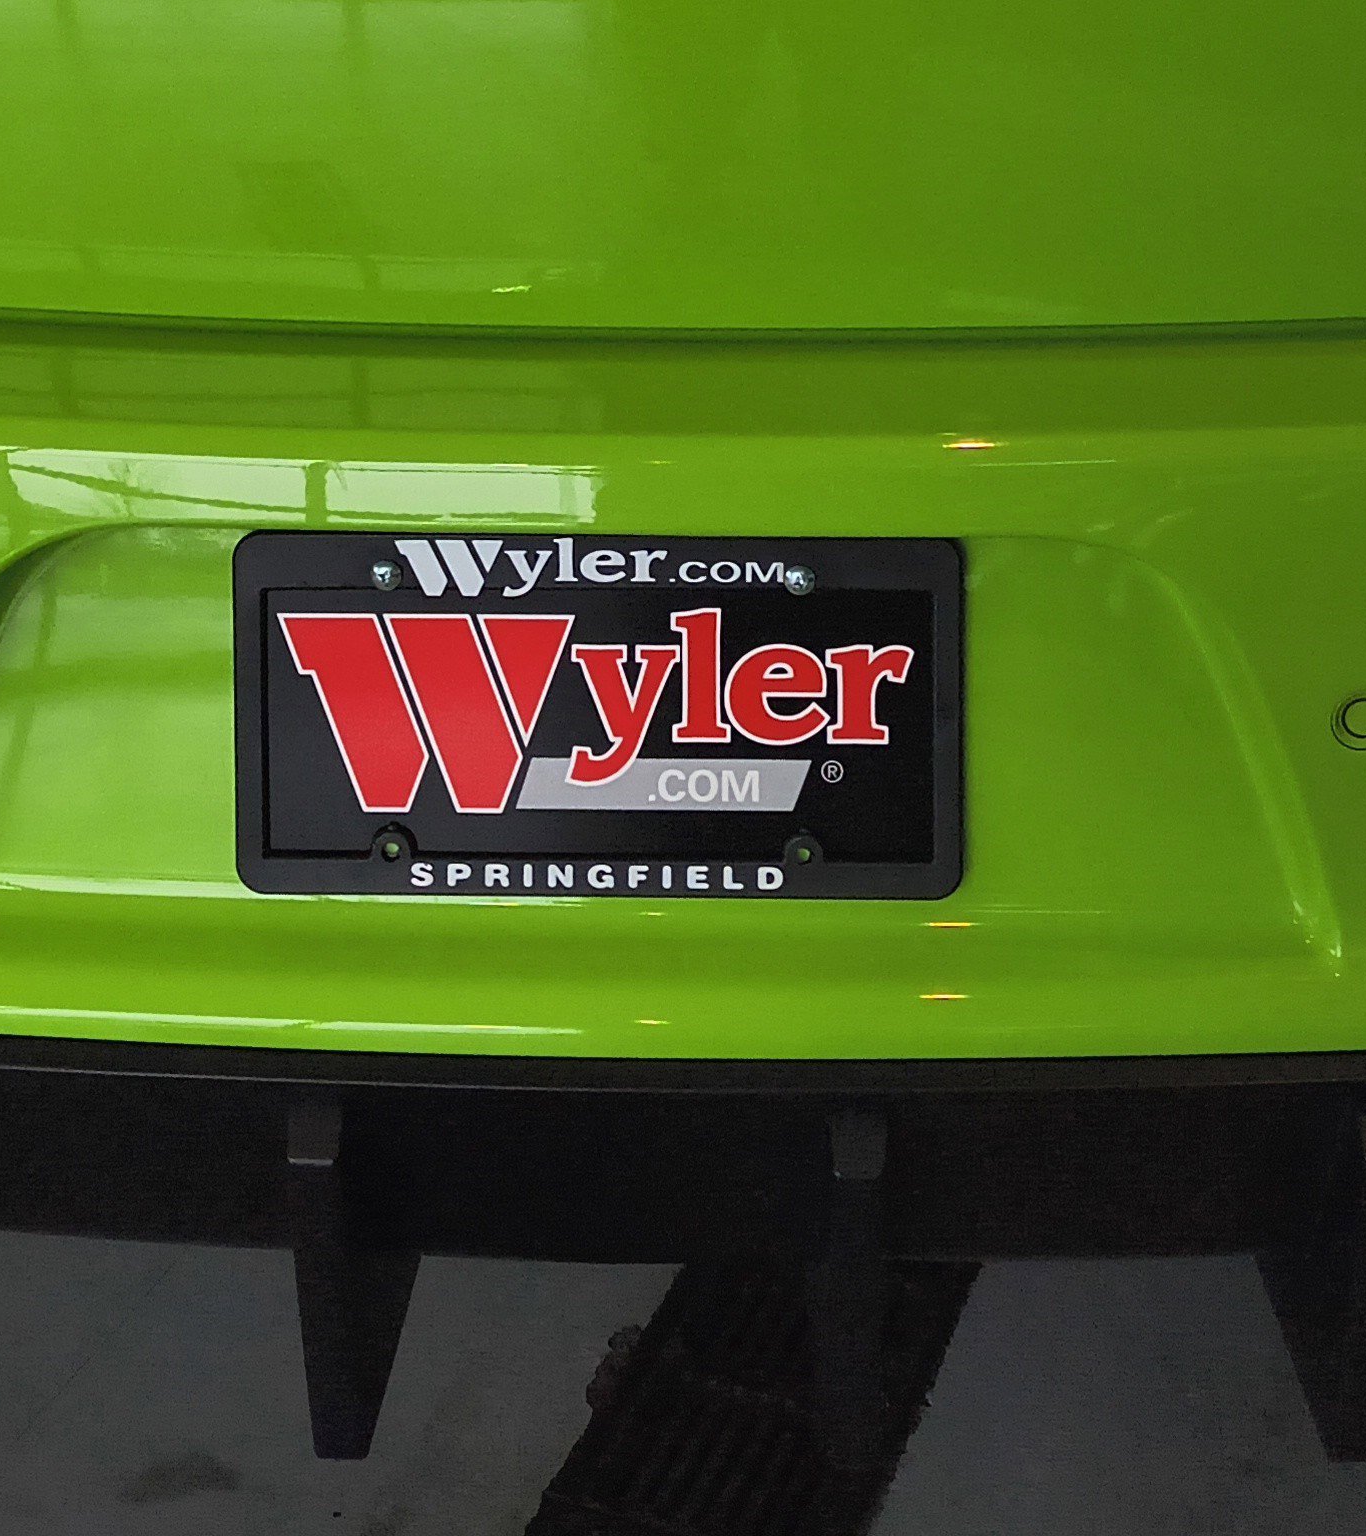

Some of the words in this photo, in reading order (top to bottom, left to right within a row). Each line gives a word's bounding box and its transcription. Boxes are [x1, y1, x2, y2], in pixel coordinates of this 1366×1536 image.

[277, 608, 915, 814] Wyler
[647, 769, 760, 803] .COM
[410, 862, 784, 891] SPRINGFIELD
